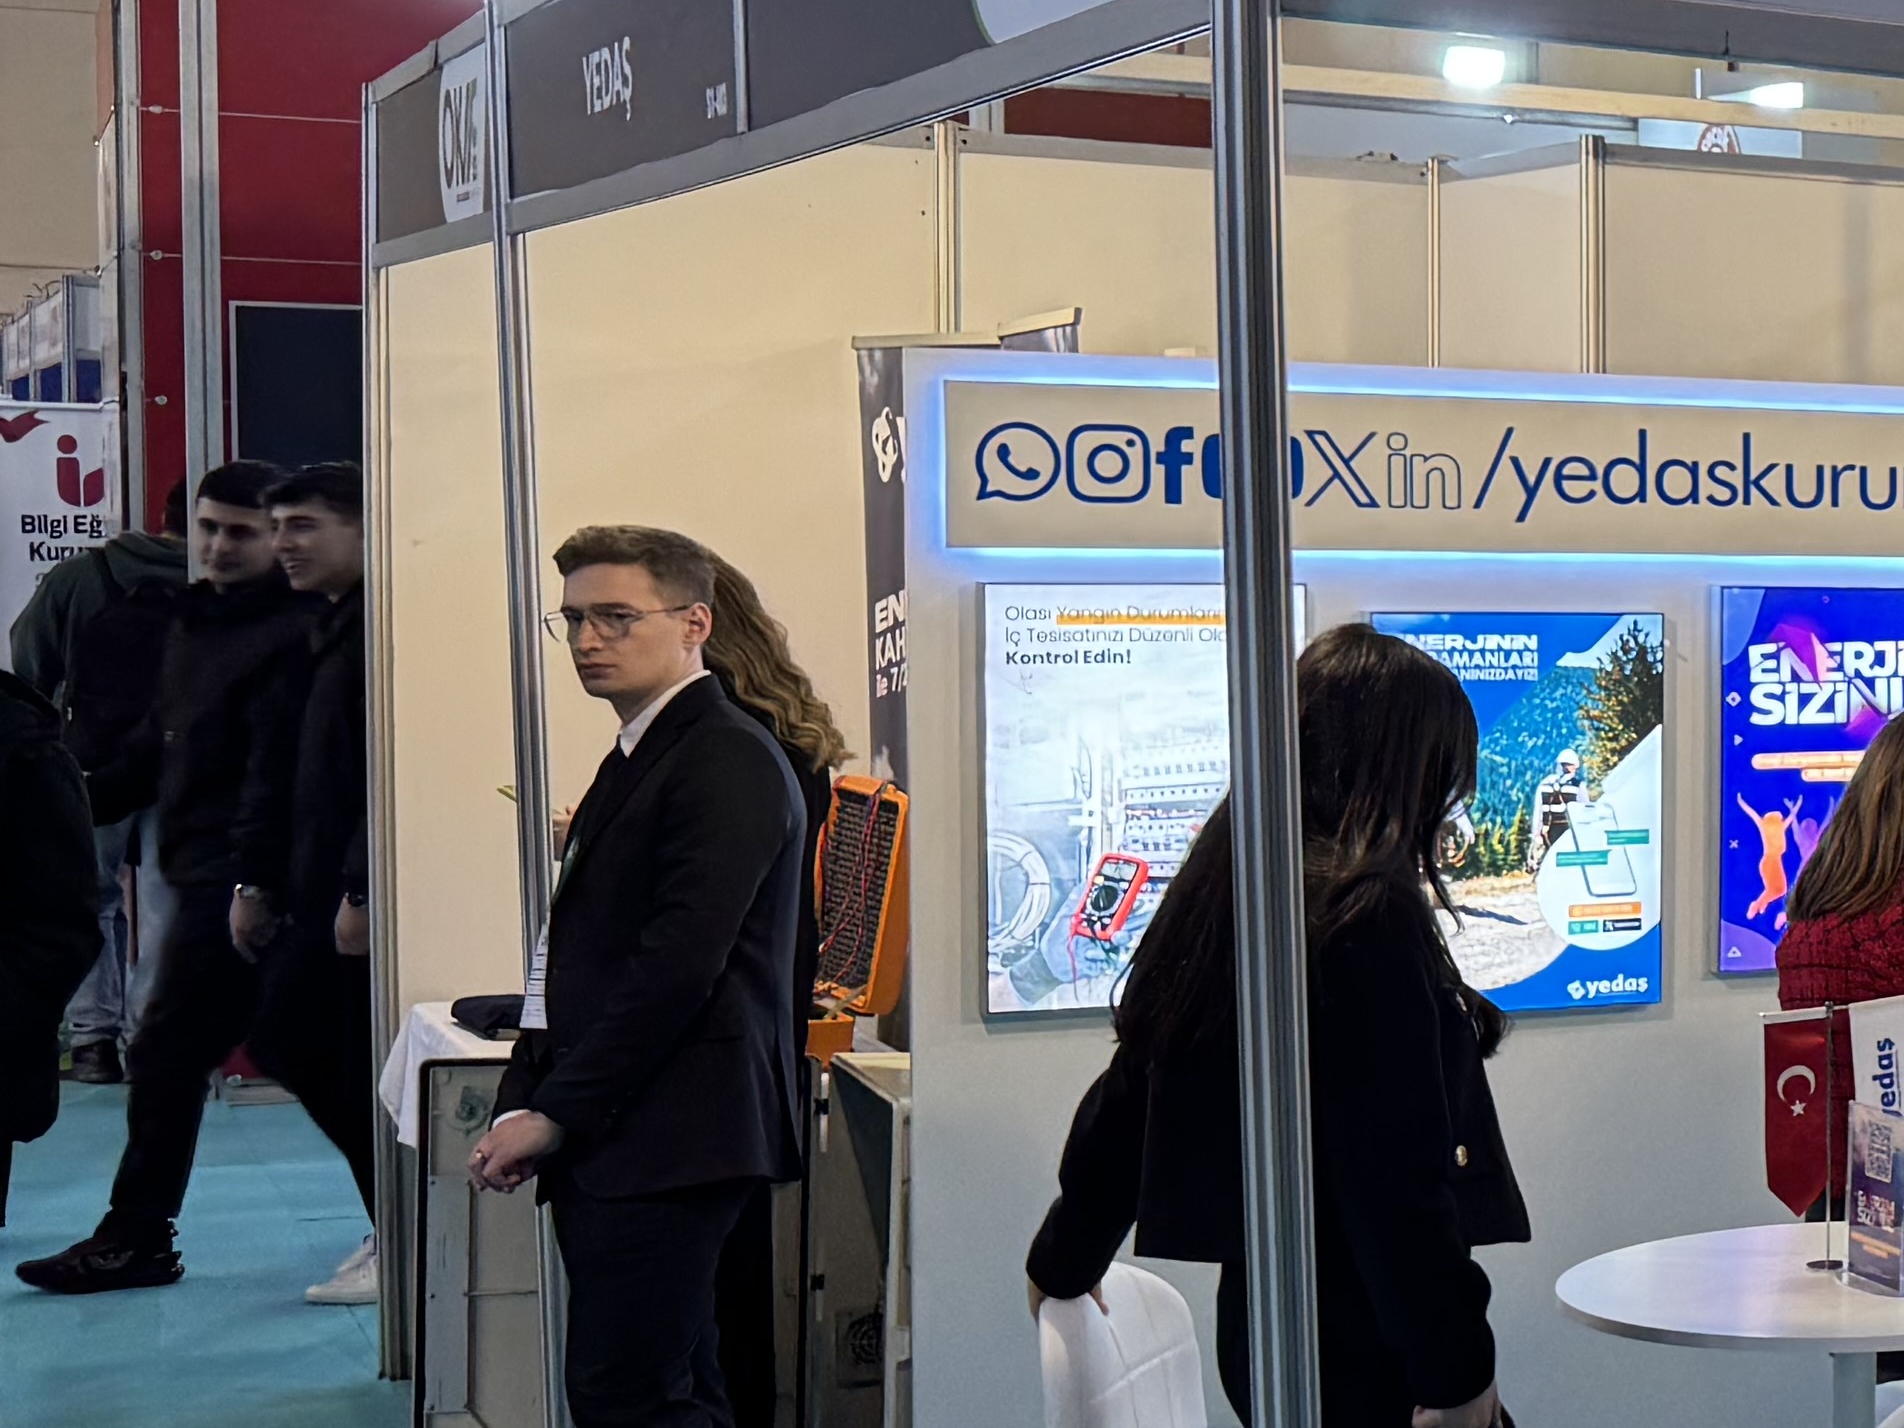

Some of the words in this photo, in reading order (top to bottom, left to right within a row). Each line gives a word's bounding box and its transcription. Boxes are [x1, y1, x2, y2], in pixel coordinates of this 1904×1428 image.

[582, 36, 633, 121] YEDAŞ
[1005, 605, 1051, 620] Olası
[1056, 606, 1121, 624] Yangın
[1026, 628, 1124, 643] Tesisatınızı
[1129, 627, 1194, 642] Düzenli
[1005, 650, 1079, 665] Kontrol
[1083, 648, 1131, 664] Edin!
